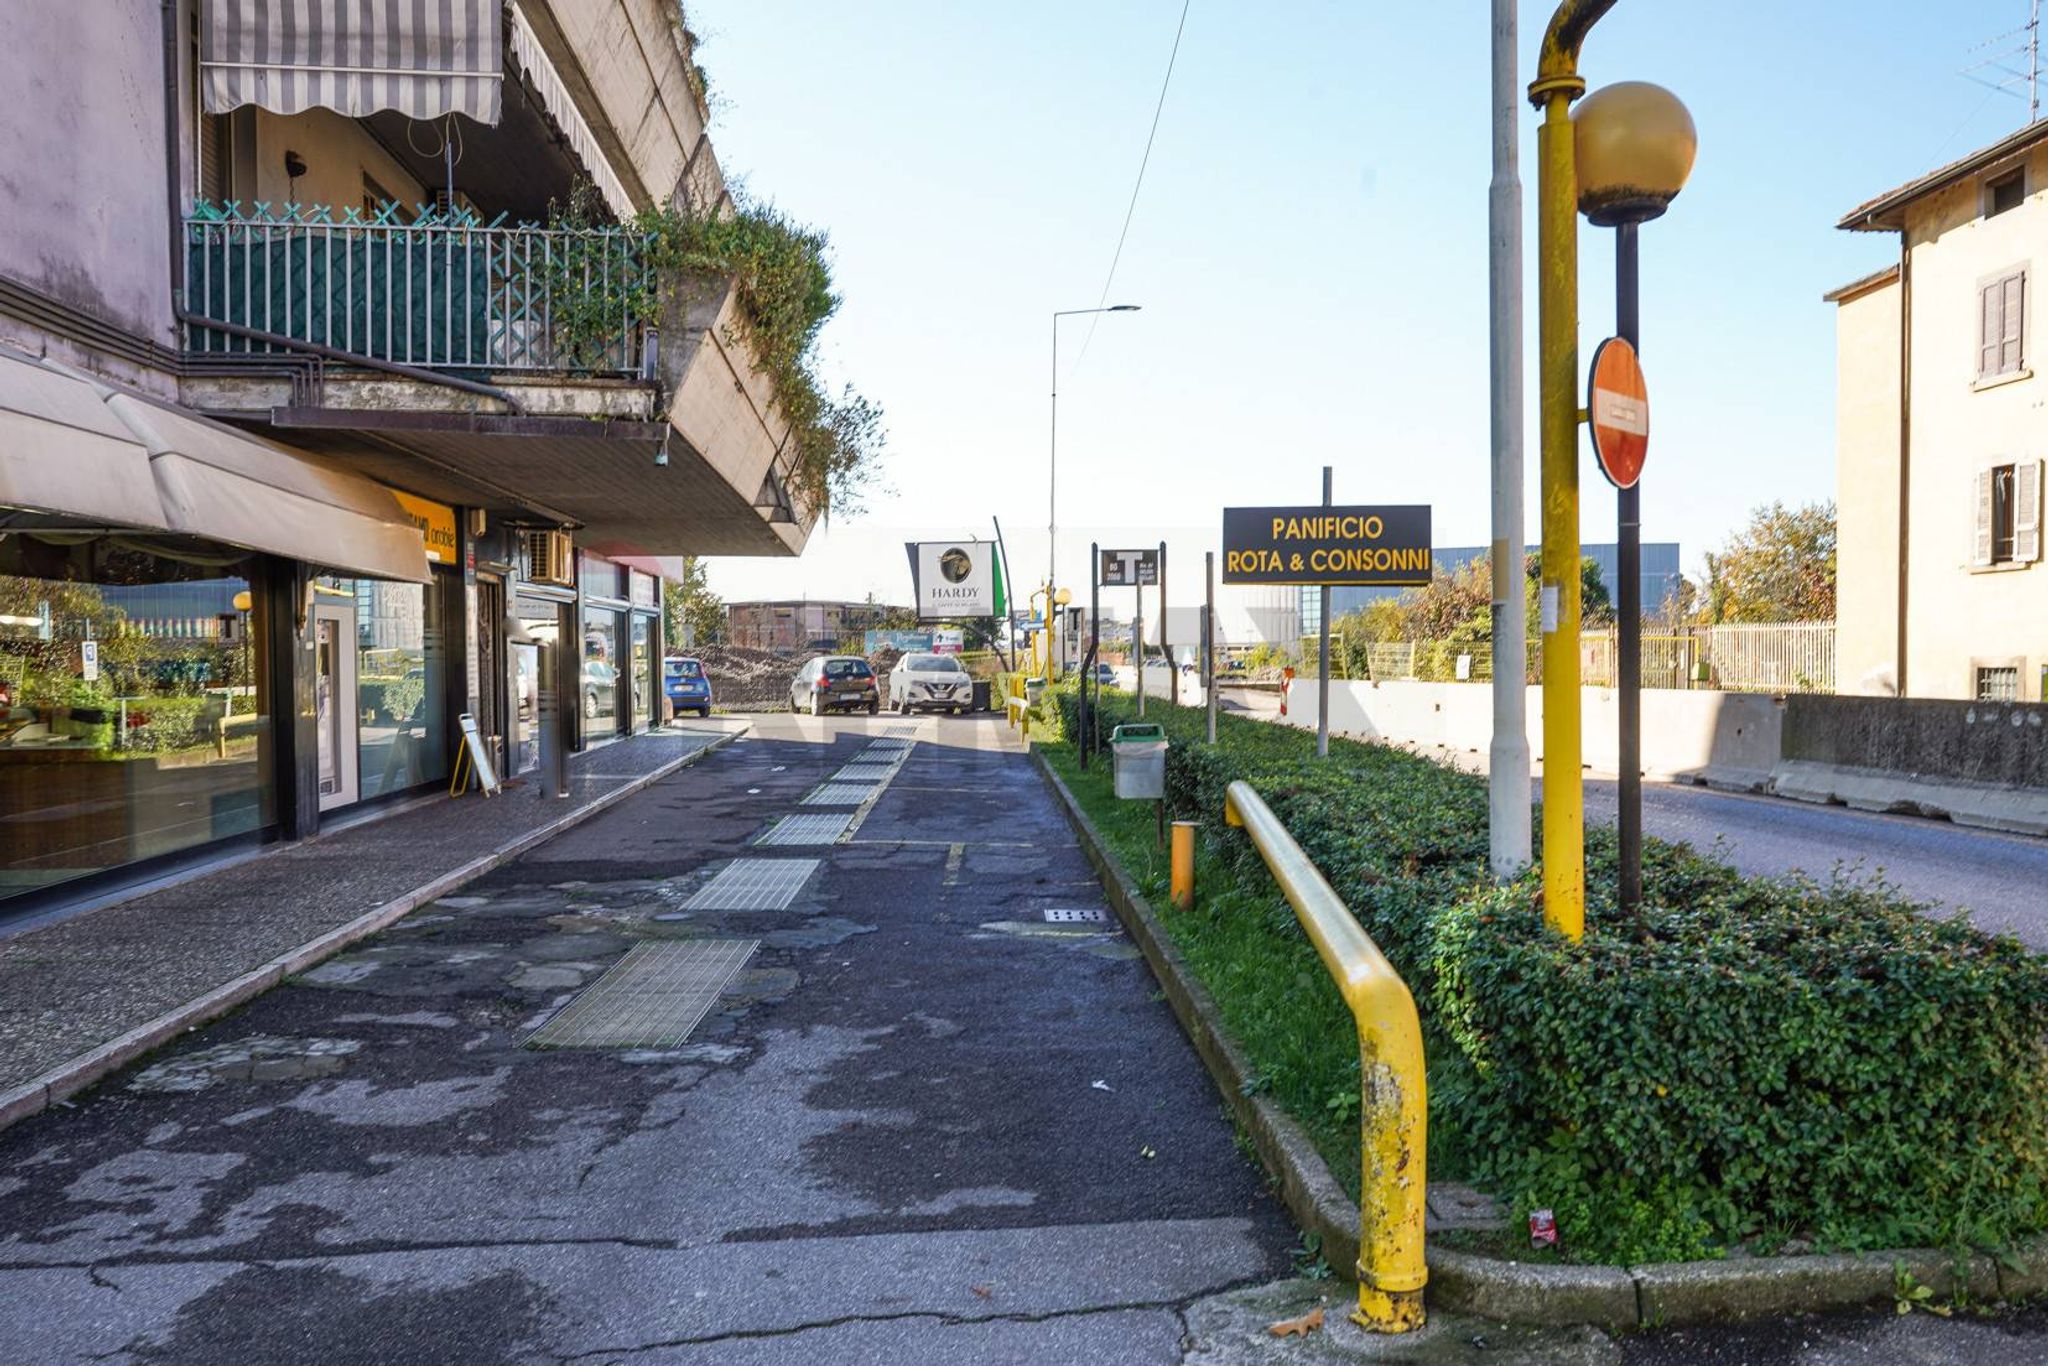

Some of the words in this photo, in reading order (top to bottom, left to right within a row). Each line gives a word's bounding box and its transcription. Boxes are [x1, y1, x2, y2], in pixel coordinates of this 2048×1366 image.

[1272, 515, 1384, 540] PANIFICIO
[1116, 551, 1144, 585] T
[1227, 549, 1283, 573] ROTA
[1289, 551, 1305, 572] &
[1310, 548, 1429, 572] CONSONNI
[932, 586, 980, 598] HARDY
